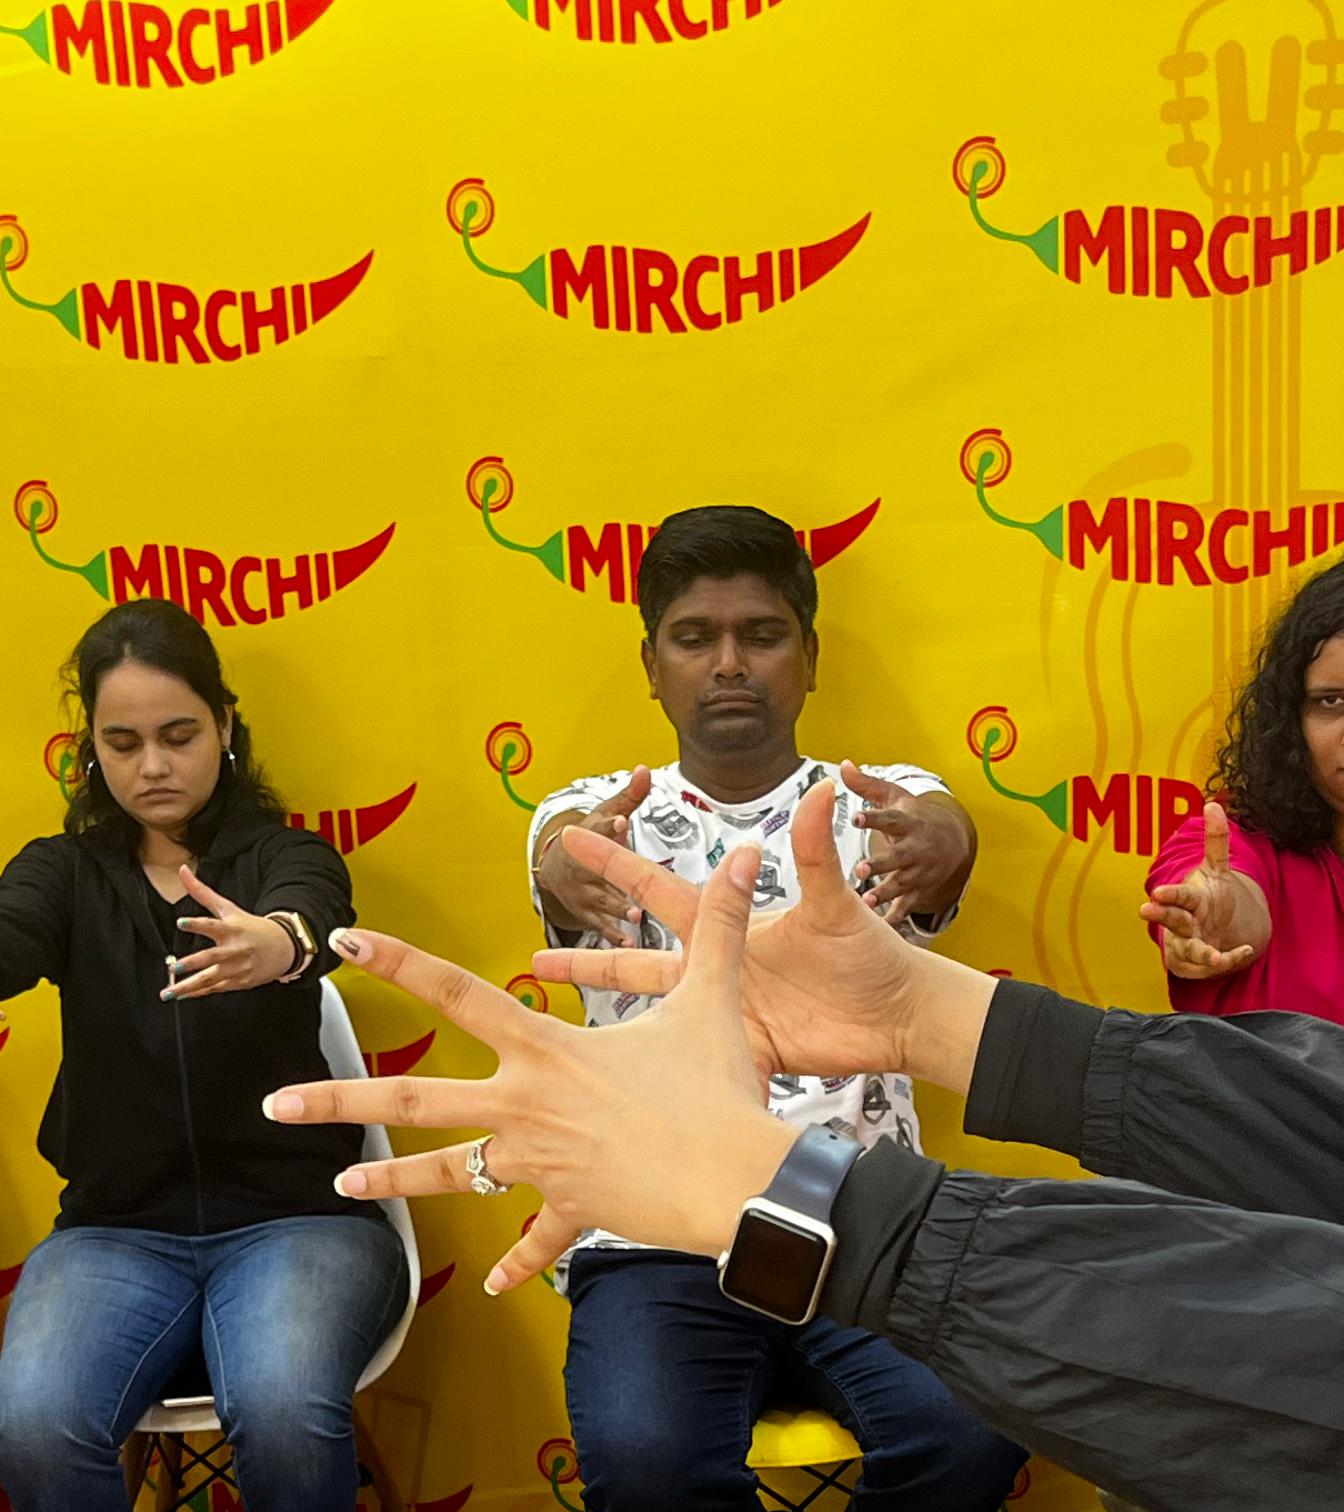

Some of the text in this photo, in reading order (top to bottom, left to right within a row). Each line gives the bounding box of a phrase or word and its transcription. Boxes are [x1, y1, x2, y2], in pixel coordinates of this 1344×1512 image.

[52, 0, 284, 88] MIRCHI
[549, 243, 796, 334] MIRCHI
[1063, 204, 1332, 299] MIRCHI
[80, 278, 309, 364] MIRCHI
[108, 542, 332, 628] MIRCHI
[1067, 496, 1330, 587] MIRCHI
